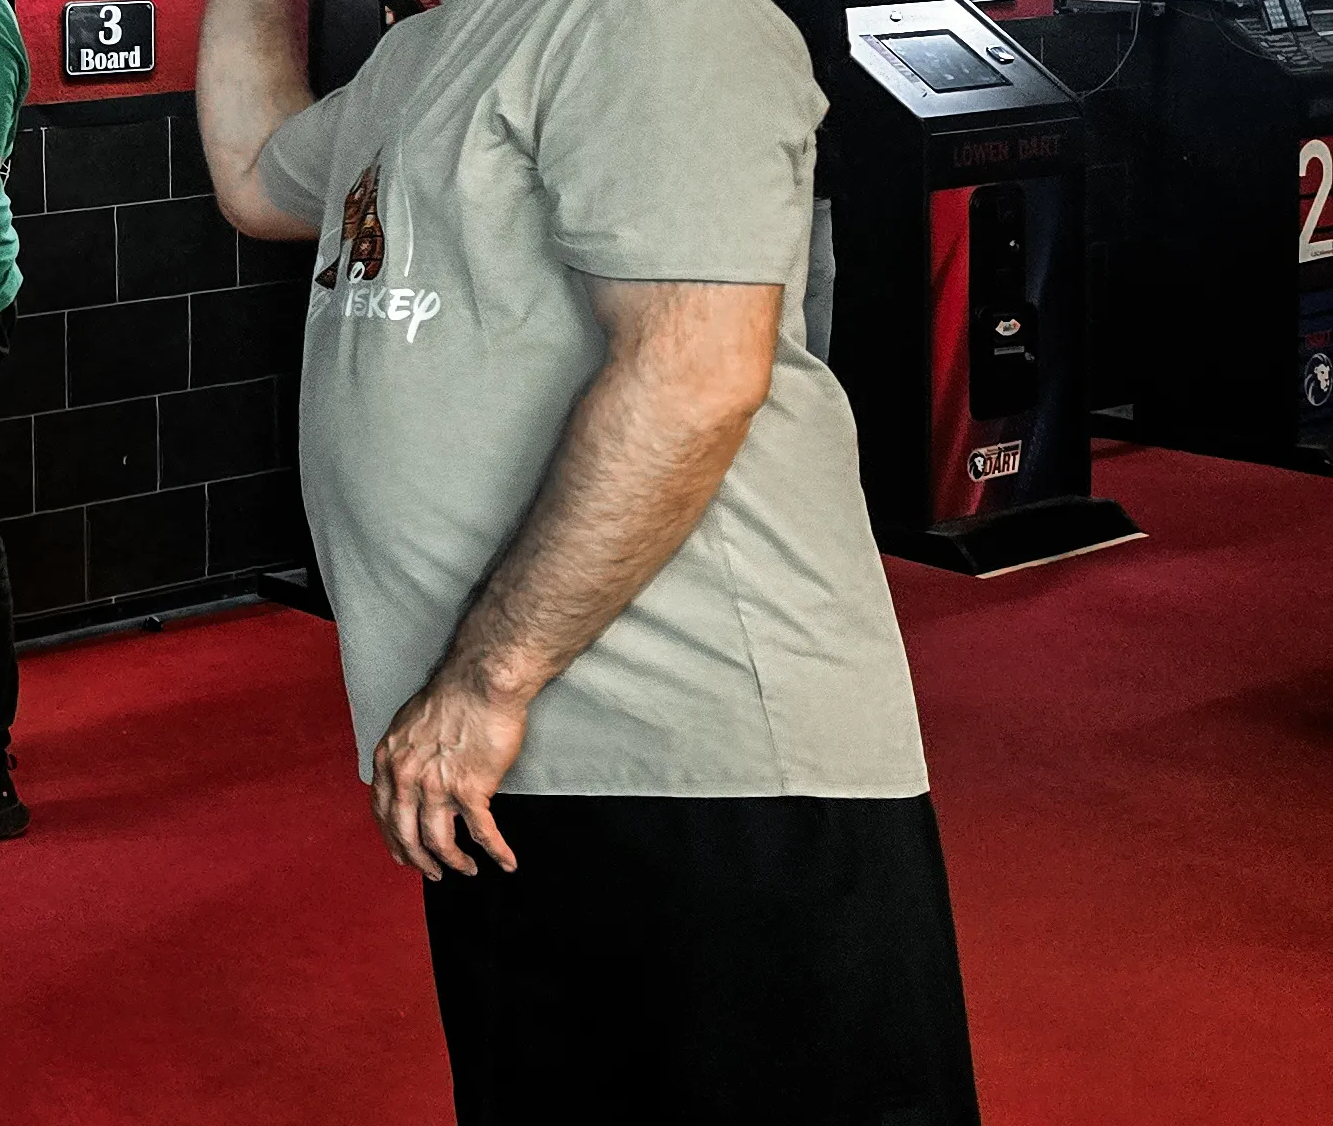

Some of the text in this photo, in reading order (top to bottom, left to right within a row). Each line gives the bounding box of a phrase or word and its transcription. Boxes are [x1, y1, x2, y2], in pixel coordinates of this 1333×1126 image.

[98, 5, 123, 44] 3
[79, 44, 141, 71] Board
[983, 450, 1020, 477] DART
